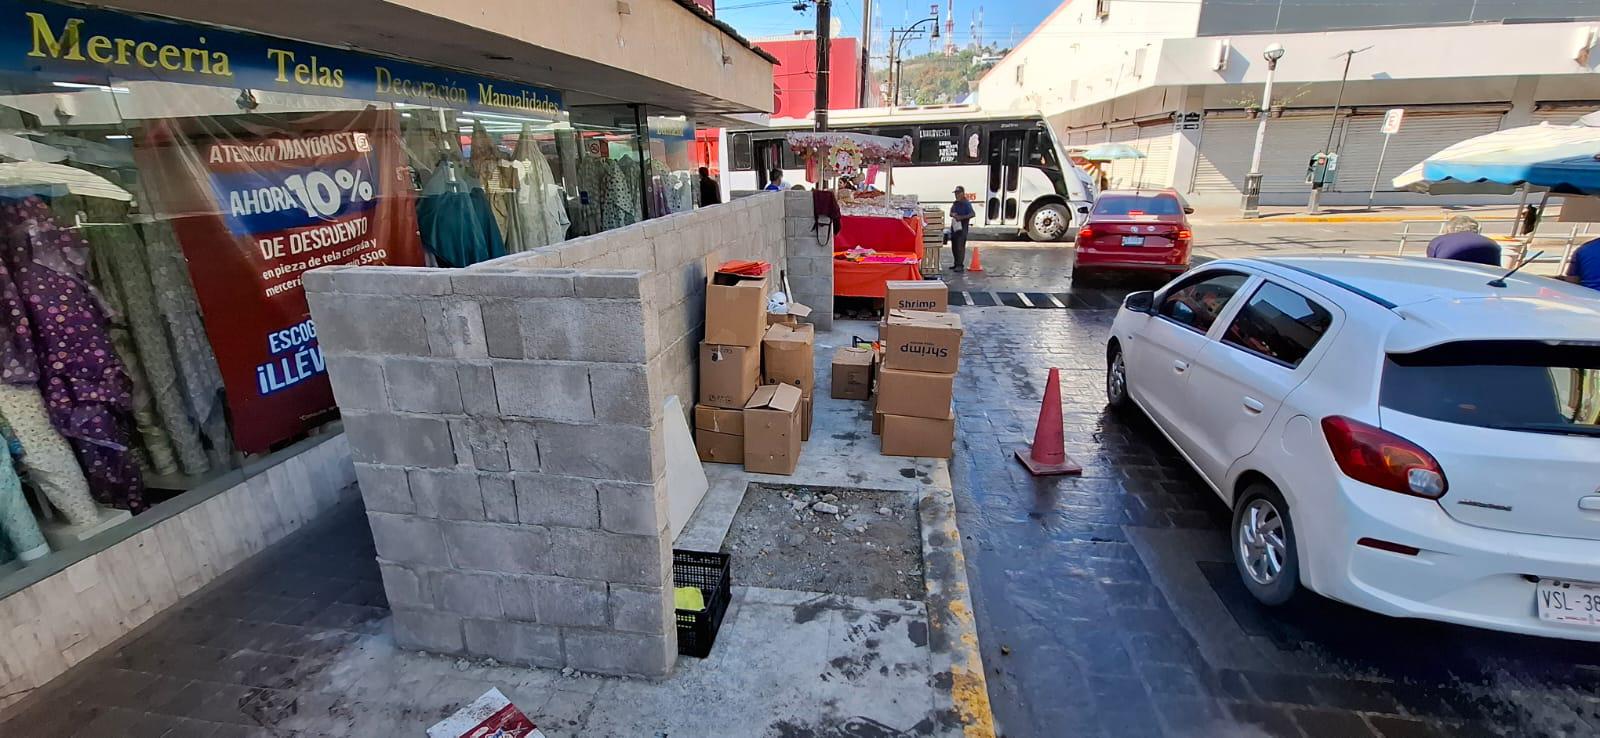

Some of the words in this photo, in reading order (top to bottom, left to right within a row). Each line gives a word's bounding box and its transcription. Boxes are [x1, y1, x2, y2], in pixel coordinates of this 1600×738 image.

[25, 12, 233, 76] Merceria
[267, 48, 344, 88] Telas
[375, 66, 468, 104] Decoración
[477, 82, 560, 115] Manualidades
[209, 142, 275, 164] ATENCIÓN
[278, 131, 356, 161] MAYORIST
[230, 186, 298, 217] AHORA
[284, 168, 373, 218] 10%
[259, 236, 287, 261] DE
[289, 216, 368, 256] DESCUENTO
[262, 271, 276, 281] en
[275, 261, 307, 279] pieza
[308, 256, 321, 268] de
[322, 250, 342, 264] tela
[342, 240, 370, 258] cerrada
[370, 238, 377, 248] y
[265, 275, 304, 298] merceri
[898, 299, 936, 310] Shrimp
[900, 343, 949, 358] Shrimp
